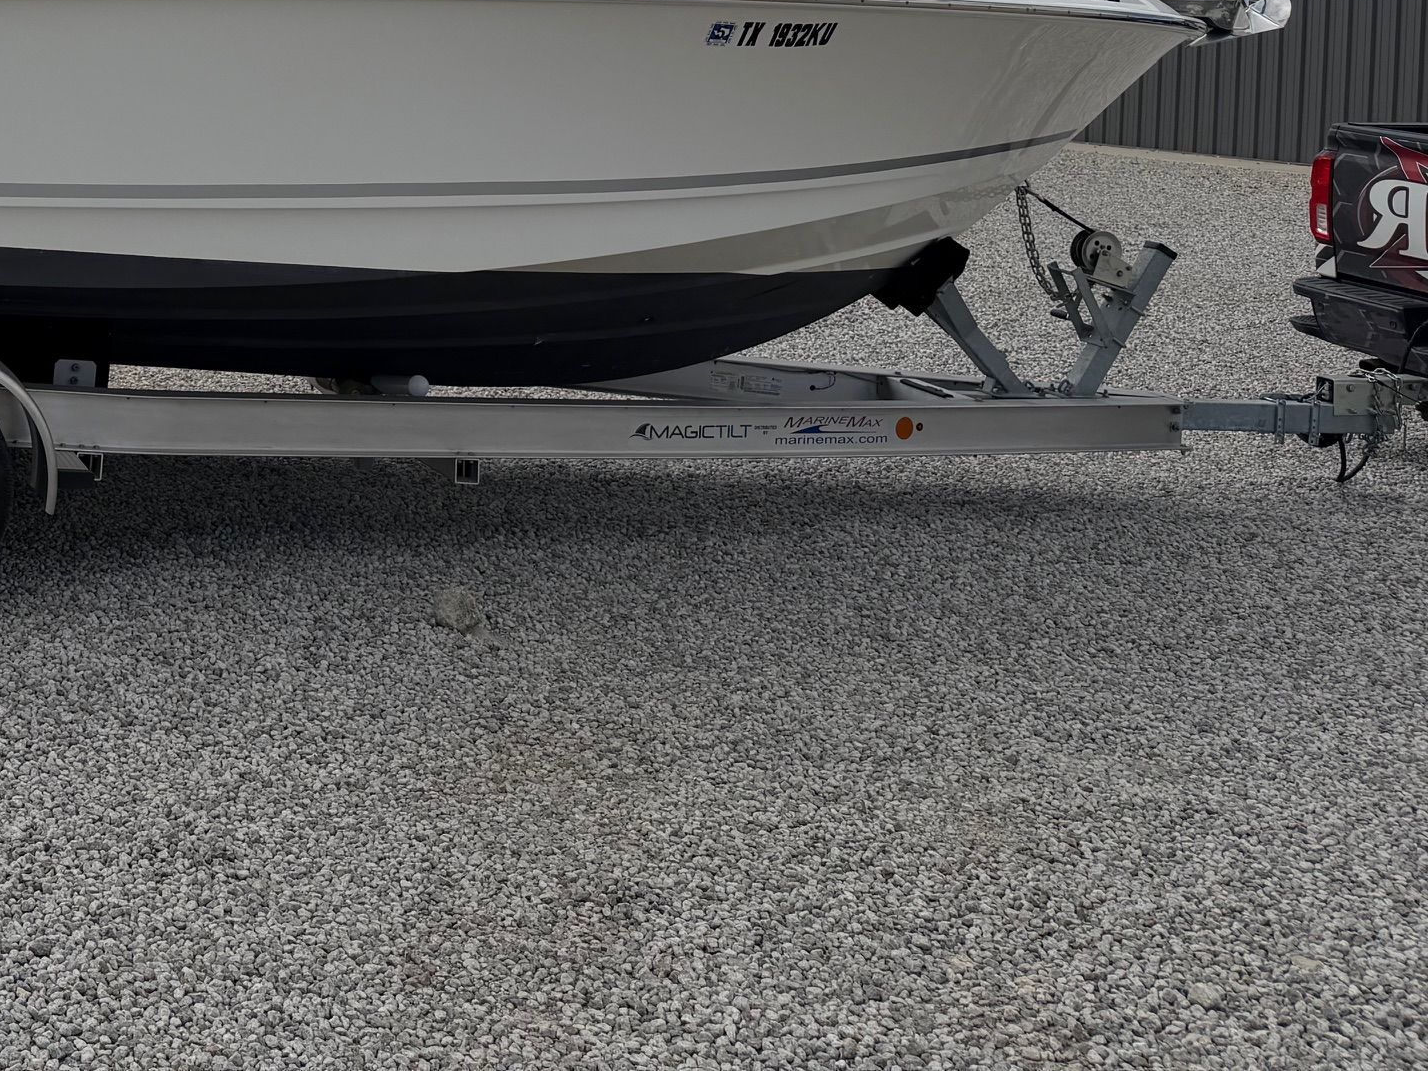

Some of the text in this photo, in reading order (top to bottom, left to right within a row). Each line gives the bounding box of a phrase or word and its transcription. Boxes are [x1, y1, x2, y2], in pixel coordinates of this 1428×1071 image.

[737, 22, 766, 47] TX
[768, 22, 839, 48] 1932KU
[649, 424, 753, 440] MAGICTILT
[775, 435, 888, 446] marinemax.com
